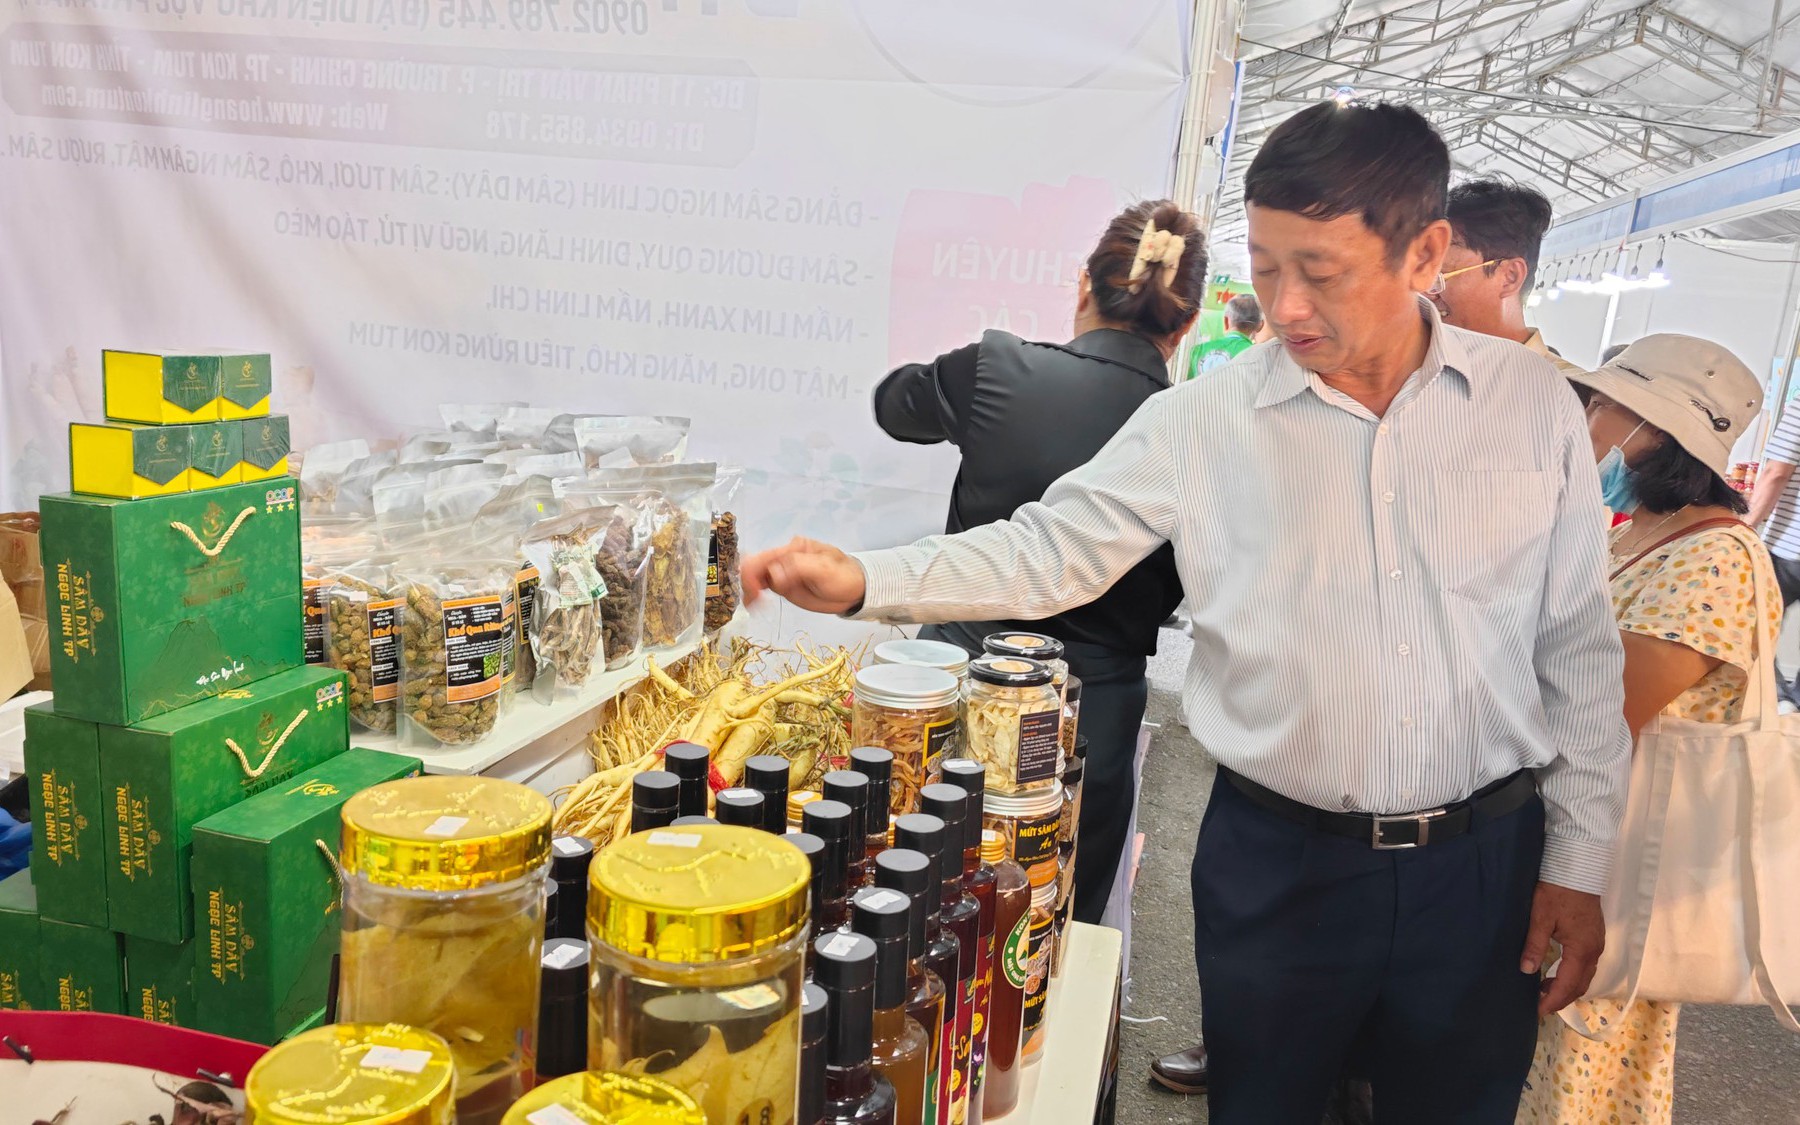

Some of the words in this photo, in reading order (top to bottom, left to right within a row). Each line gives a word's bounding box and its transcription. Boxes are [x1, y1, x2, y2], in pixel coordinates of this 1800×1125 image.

[57, 563, 70, 601] NGỌC
[73, 574, 88, 610] SÂM
[61, 605, 73, 636] LINH
[76, 615, 91, 649] DÂY
[63, 640, 75, 657] TP
[42, 773, 54, 809] NGỌC
[58, 785, 71, 818] SÂM
[115, 787, 128, 823] NGỌC
[45, 812, 57, 841] LINH
[132, 799, 146, 832] SÂM
[47, 845, 58, 861] TP
[60, 822, 74, 854] DÂY
[118, 826, 130, 856] LINH
[133, 837, 148, 870] DÂY
[120, 859, 131, 876] TP
[208, 890, 220, 926] NGỌC
[224, 904, 239, 936] SÂM
[210, 929, 222, 959] LINH
[225, 940, 240, 973] DÂY
[211, 962, 222, 978] TP
[75, 989, 89, 1011] SÂ
